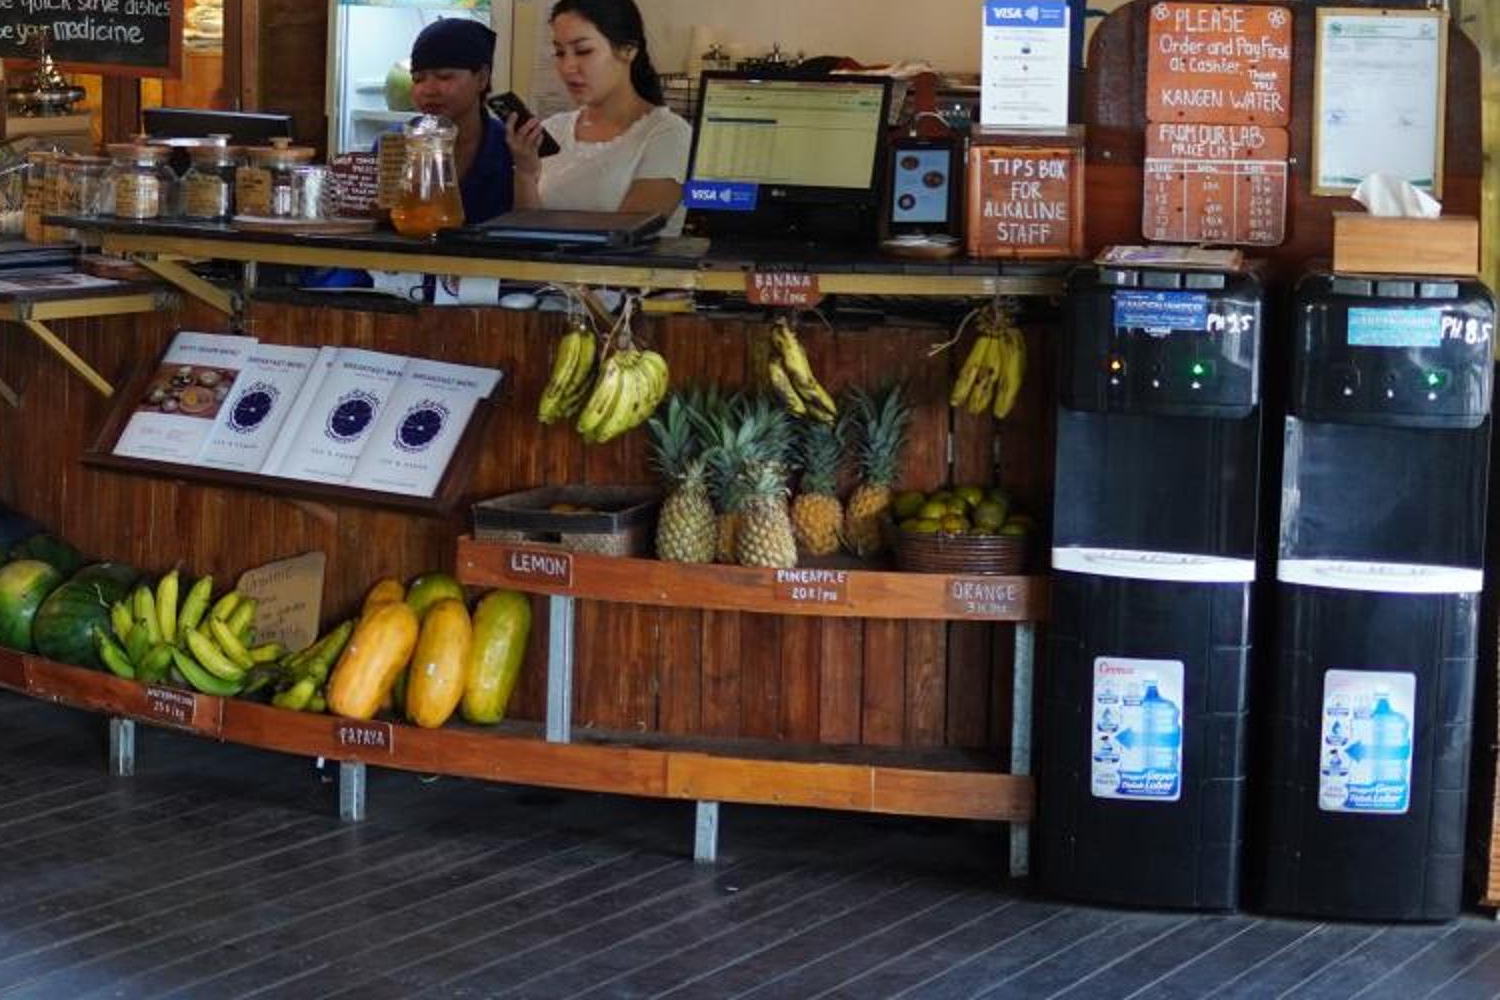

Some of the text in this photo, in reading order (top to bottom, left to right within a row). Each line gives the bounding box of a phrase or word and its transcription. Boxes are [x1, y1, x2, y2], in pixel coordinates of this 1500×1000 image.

[992, 7, 1023, 20] VISA
[1174, 8, 1246, 33] PLEASE
[1159, 33, 1205, 55] Order
[1206, 37, 1234, 56] and
[1161, 88, 1285, 113] KANGEN WATER
[988, 157, 1067, 181] TIPS BOX
[691, 188, 717, 201] VISA
[1011, 180, 1043, 201] FOR
[983, 200, 1068, 221] ALKALINE
[996, 221, 1052, 245] STAFF
[511, 551, 567, 577] LEMON
[776, 569, 848, 584] PINEAPPLE
[952, 581, 1016, 601] ORANGE
[339, 727, 386, 746] PAPAYA
